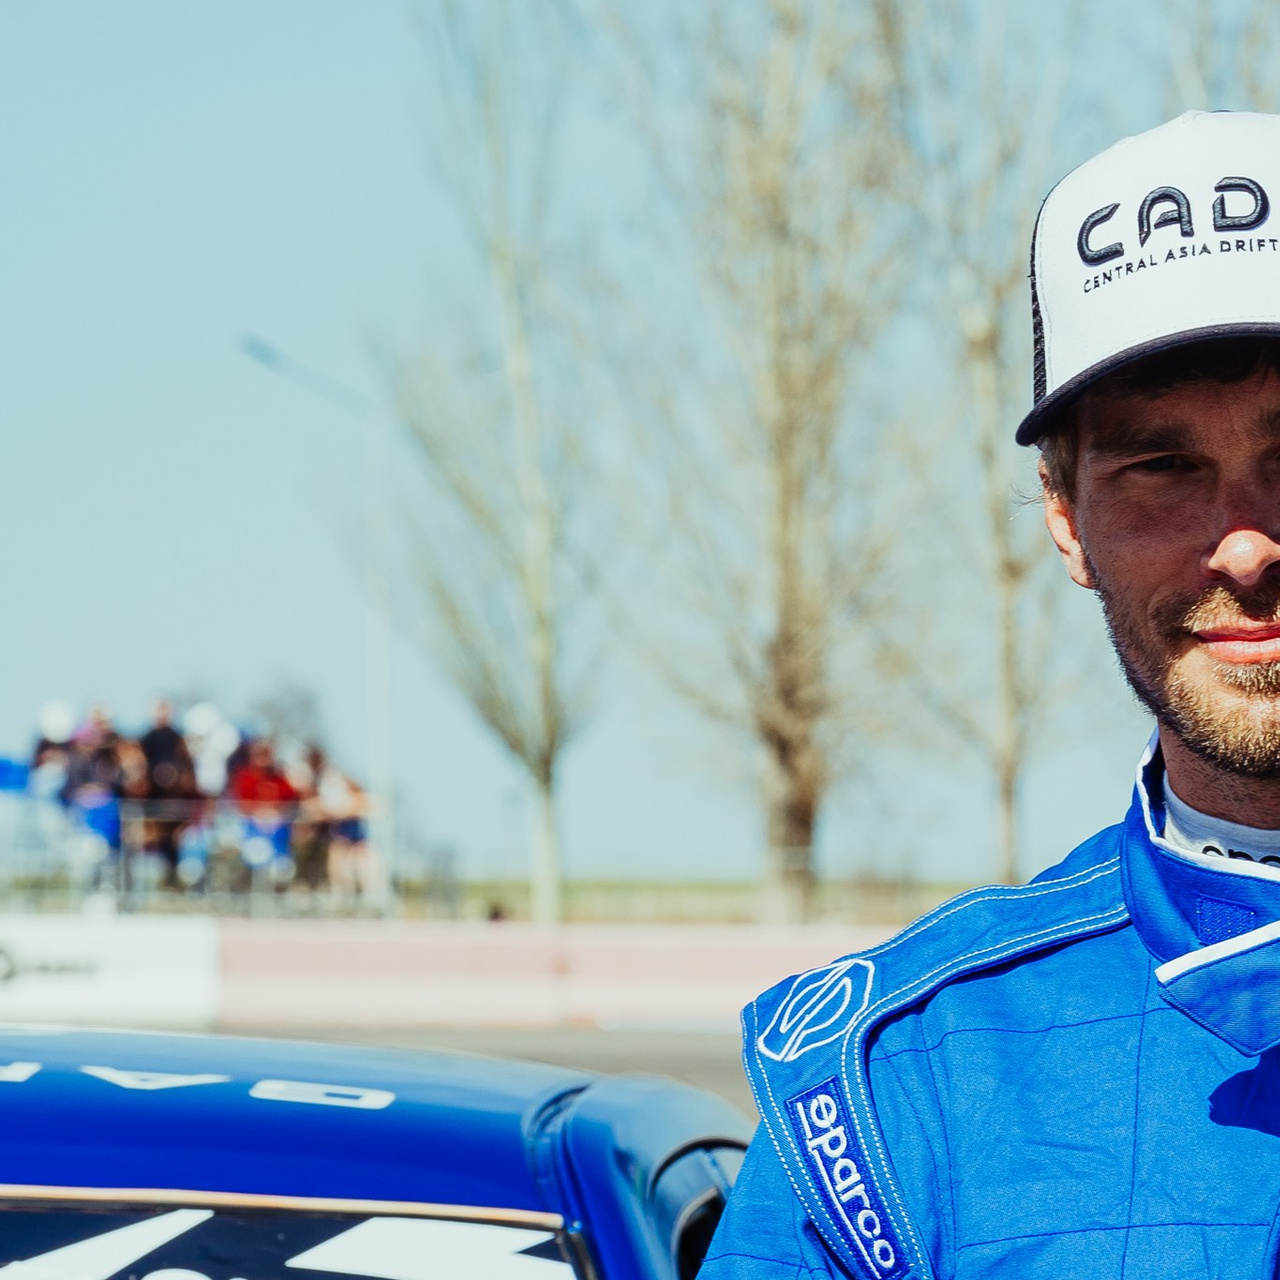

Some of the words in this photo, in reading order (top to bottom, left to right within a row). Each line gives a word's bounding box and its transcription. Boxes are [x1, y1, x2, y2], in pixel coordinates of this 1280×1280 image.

[1083, 255, 1158, 294] CENTRAL
[1164, 243, 1212, 263] ASIA
[1219, 238, 1279, 253] DRIFT
[803, 1093, 896, 1270] sparco
